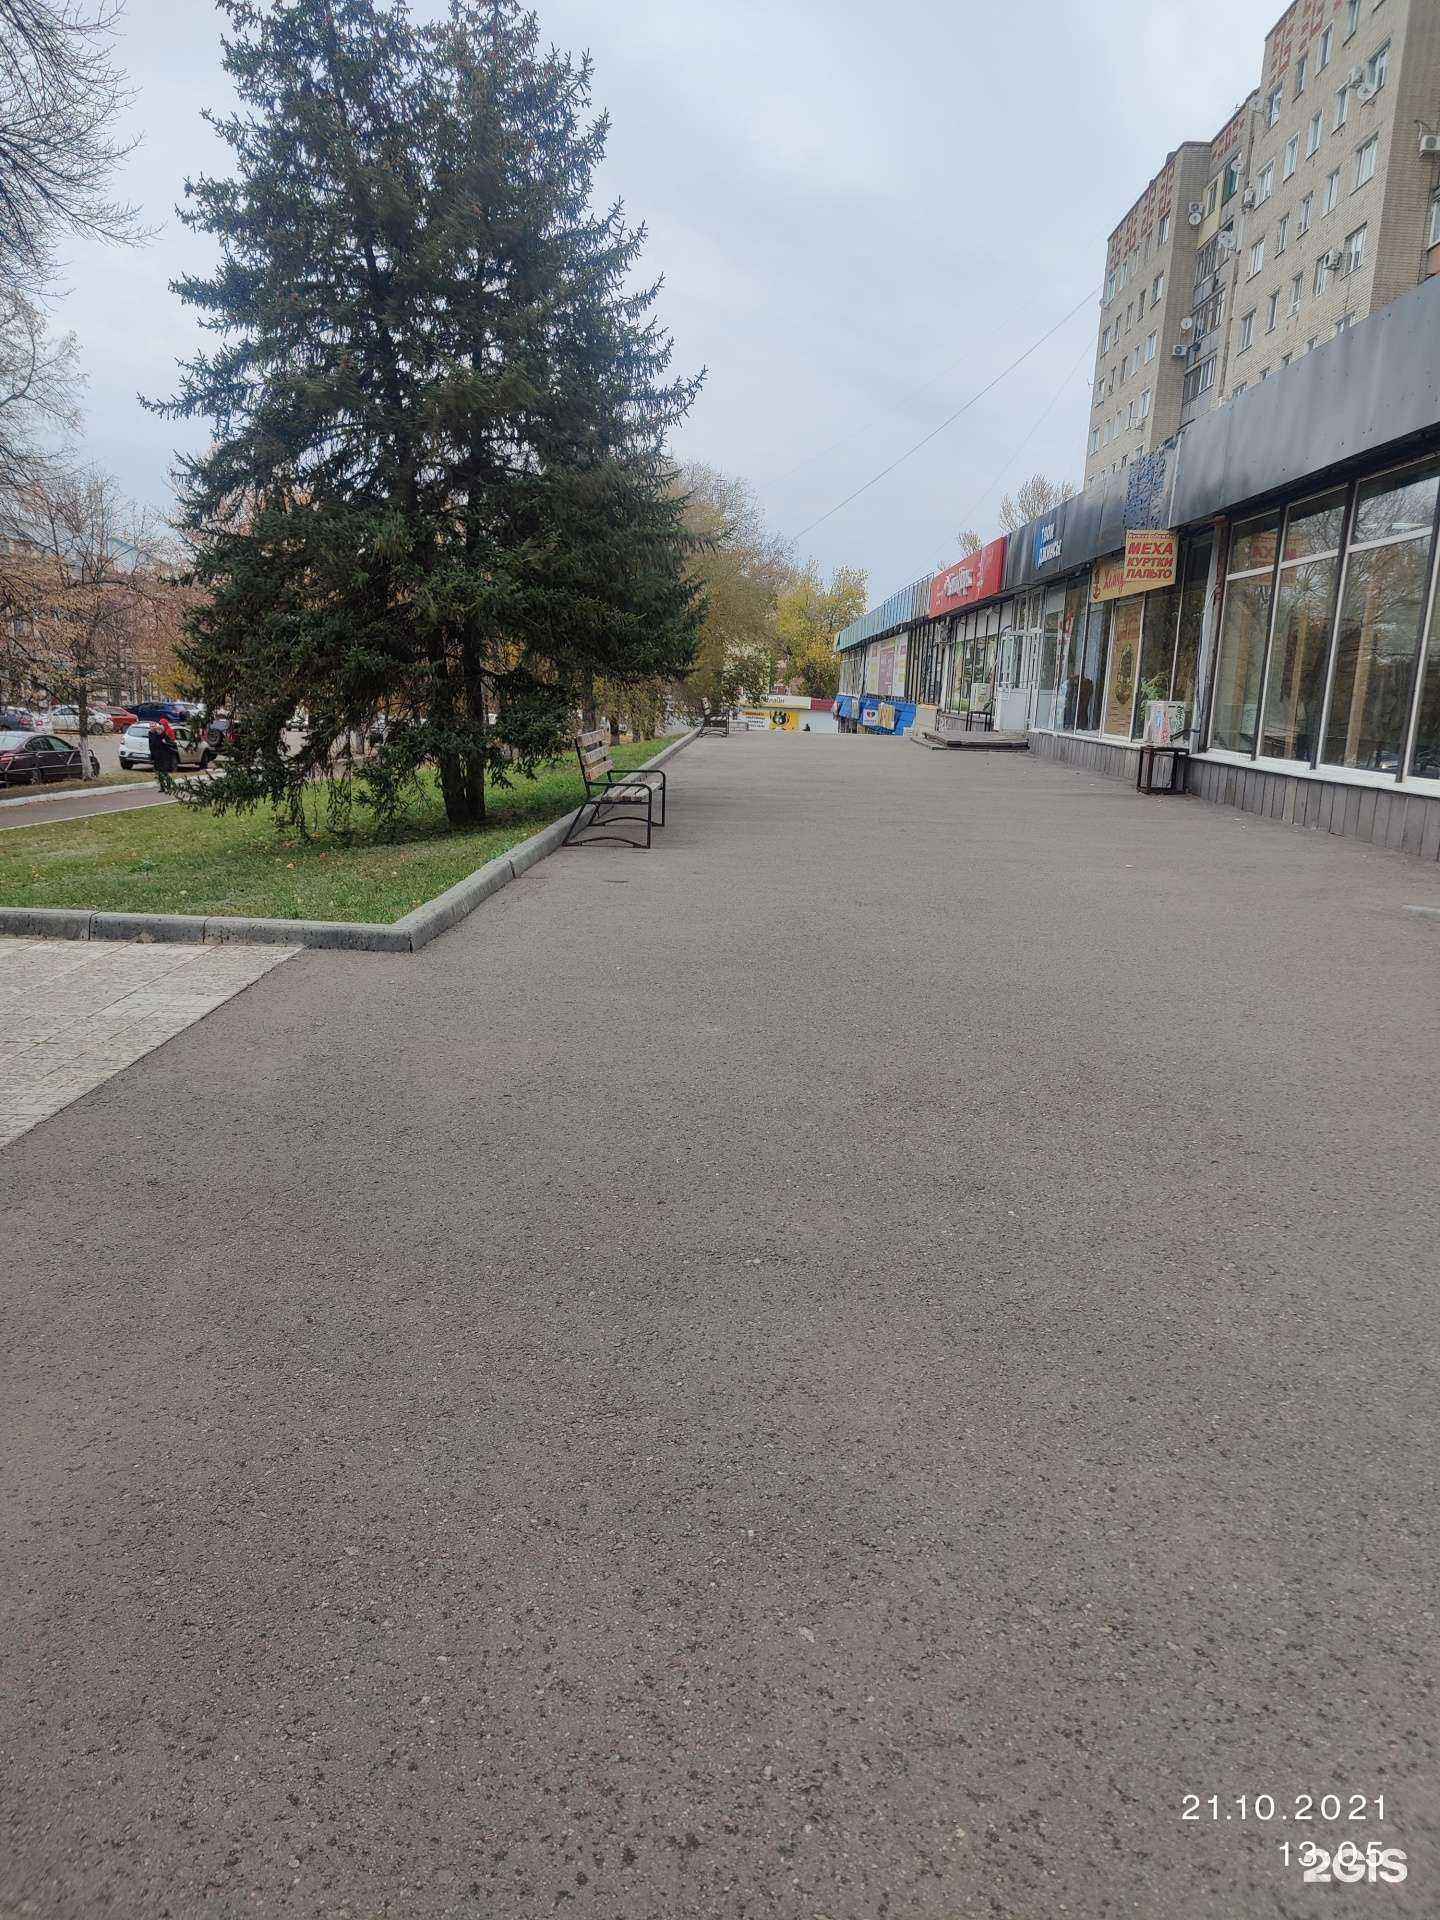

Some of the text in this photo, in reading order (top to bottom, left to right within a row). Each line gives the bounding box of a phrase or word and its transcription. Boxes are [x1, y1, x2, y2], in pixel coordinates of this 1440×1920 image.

[1128, 542, 1173, 555] МЕХА
[1127, 557, 1174, 567] КУРТКИ
[1126, 568, 1173, 579] ПАЛЬТО
